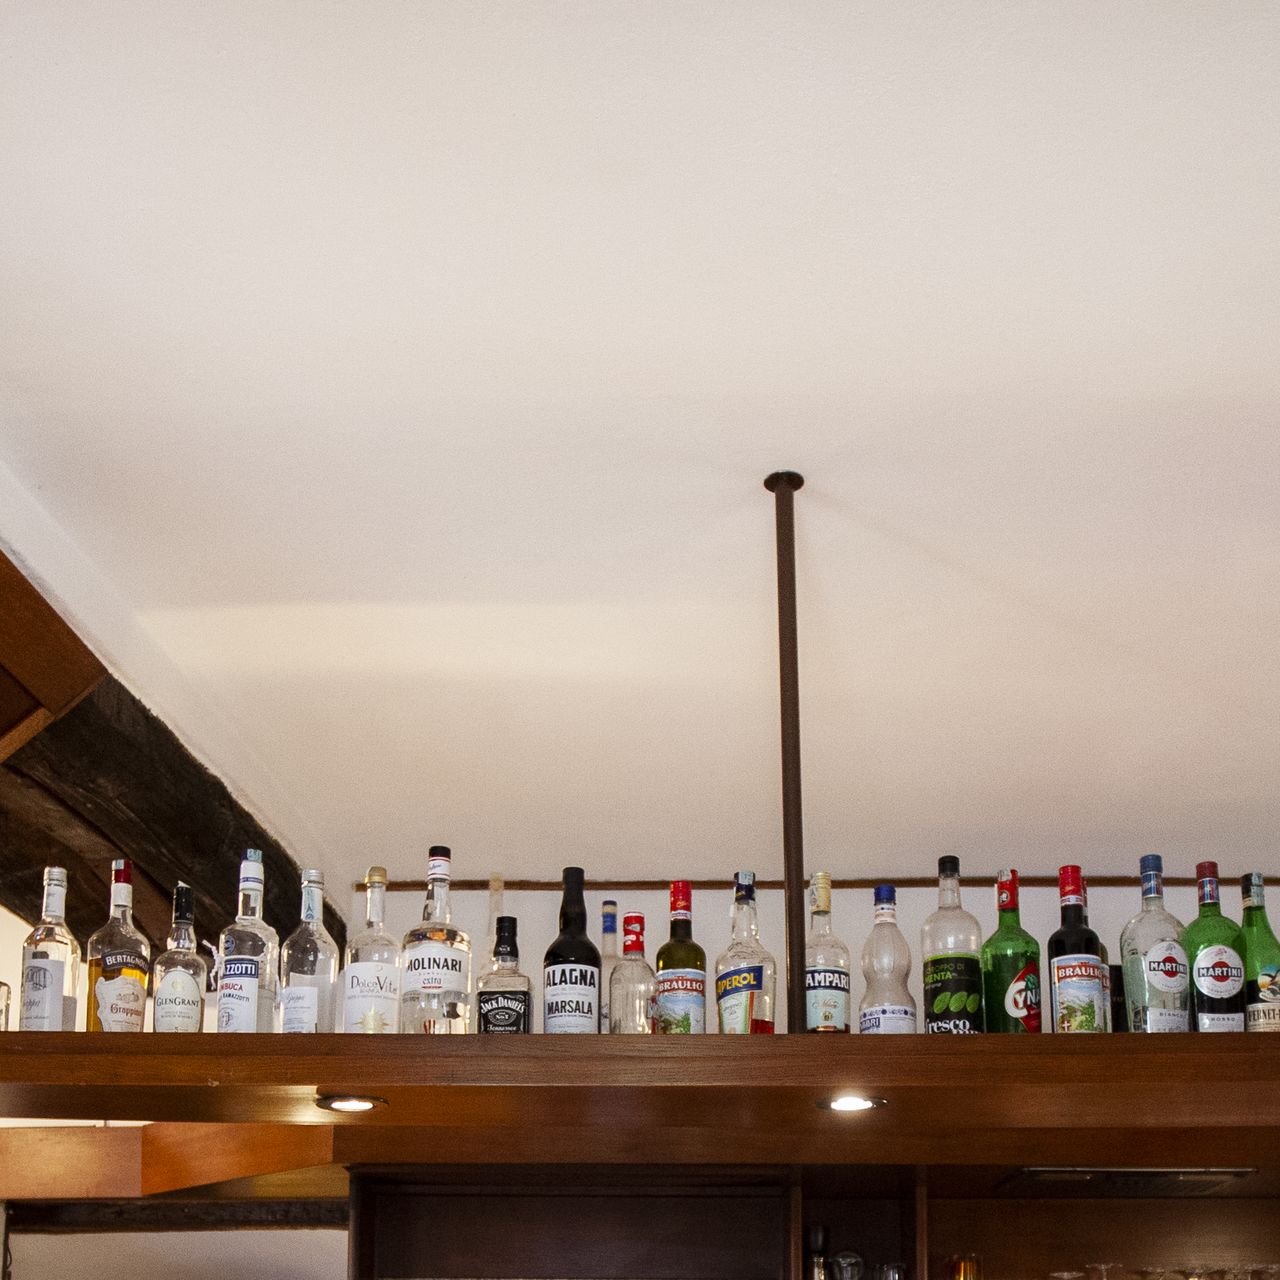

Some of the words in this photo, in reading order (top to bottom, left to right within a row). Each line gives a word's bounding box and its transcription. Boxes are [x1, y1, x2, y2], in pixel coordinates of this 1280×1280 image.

[224, 964, 256, 974] ZZOTTI
[407, 957, 461, 972] MOLINARI
[546, 968, 596, 988] ALAGNA
[926, 971, 952, 983] ENTA
[1199, 967, 1240, 976] MARTINI
[659, 980, 703, 991] BRAULIO
[806, 972, 850, 988] AMPARI
[481, 1000, 498, 1013] JACK
[547, 1000, 593, 1016] MARSALA
